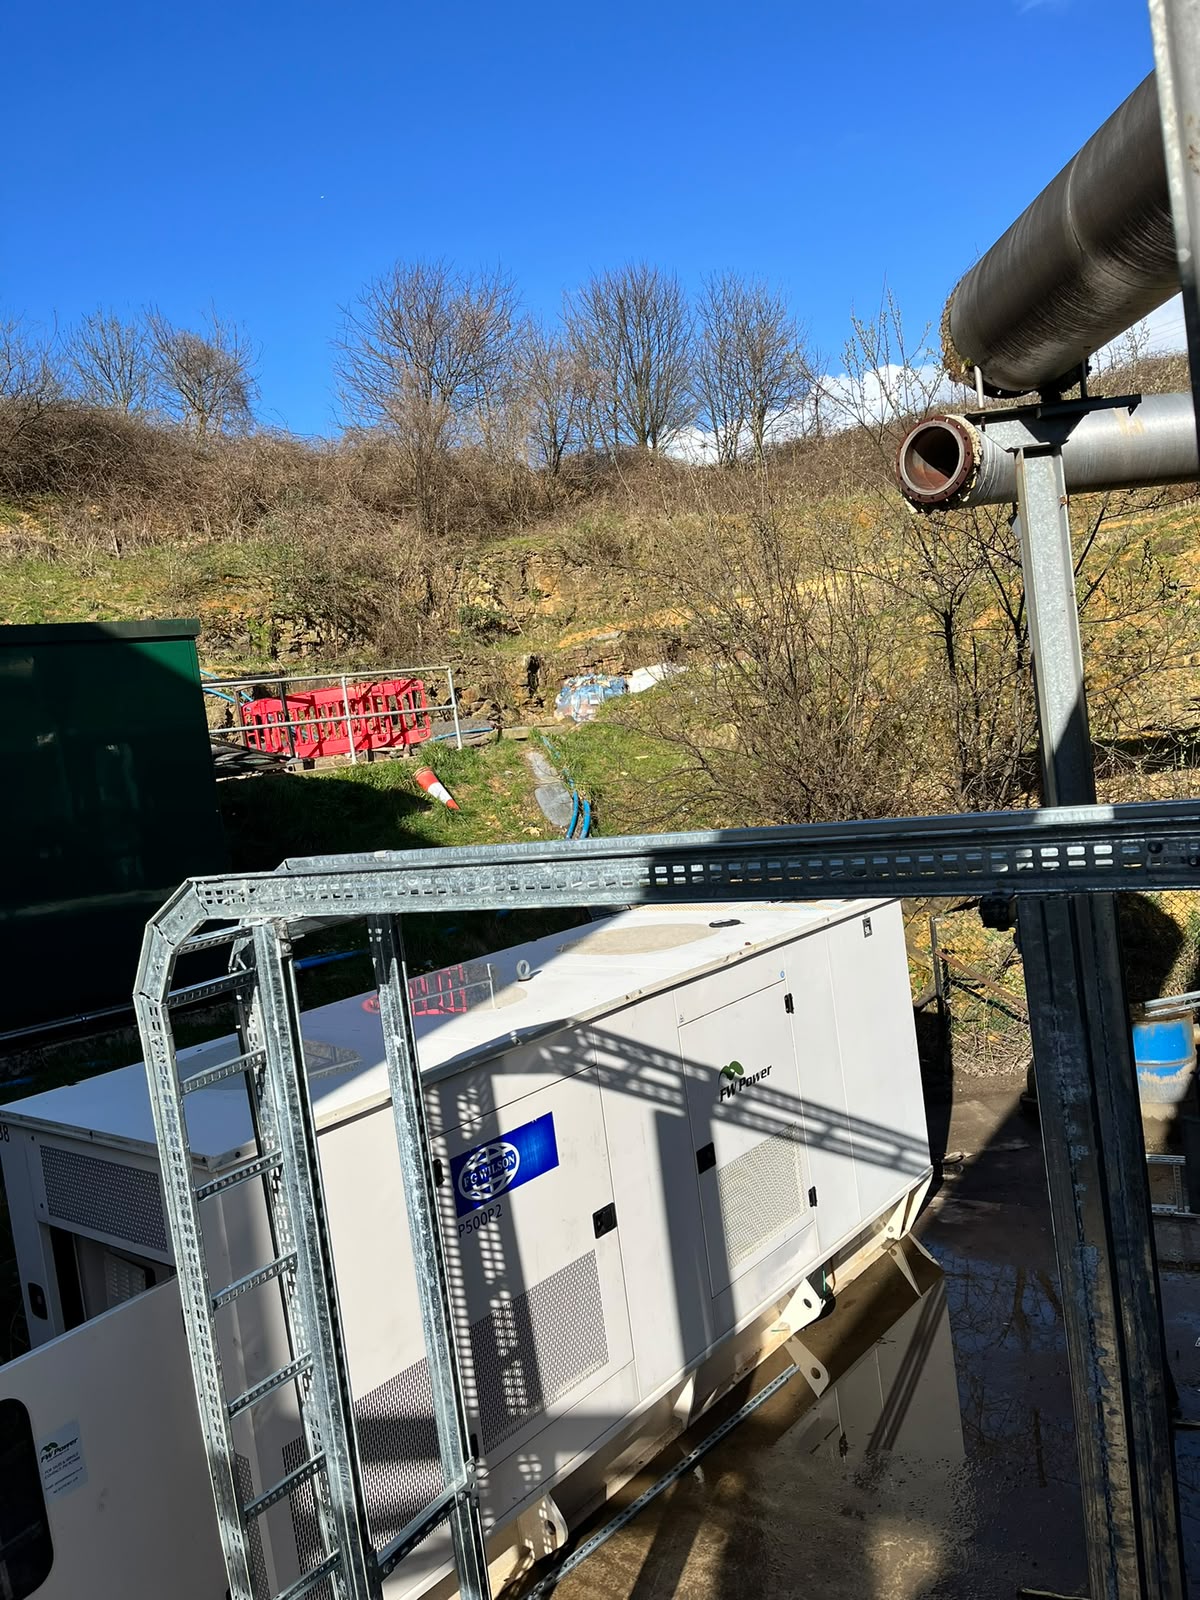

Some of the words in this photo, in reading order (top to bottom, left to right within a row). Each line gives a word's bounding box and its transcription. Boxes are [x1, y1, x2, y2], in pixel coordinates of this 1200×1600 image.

[720, 1081, 737, 1103] FW
[739, 1065, 772, 1092] Power
[463, 1173, 478, 1188] FG
[479, 1154, 516, 1180] WILSON
[458, 1203, 503, 1239] P500P2
